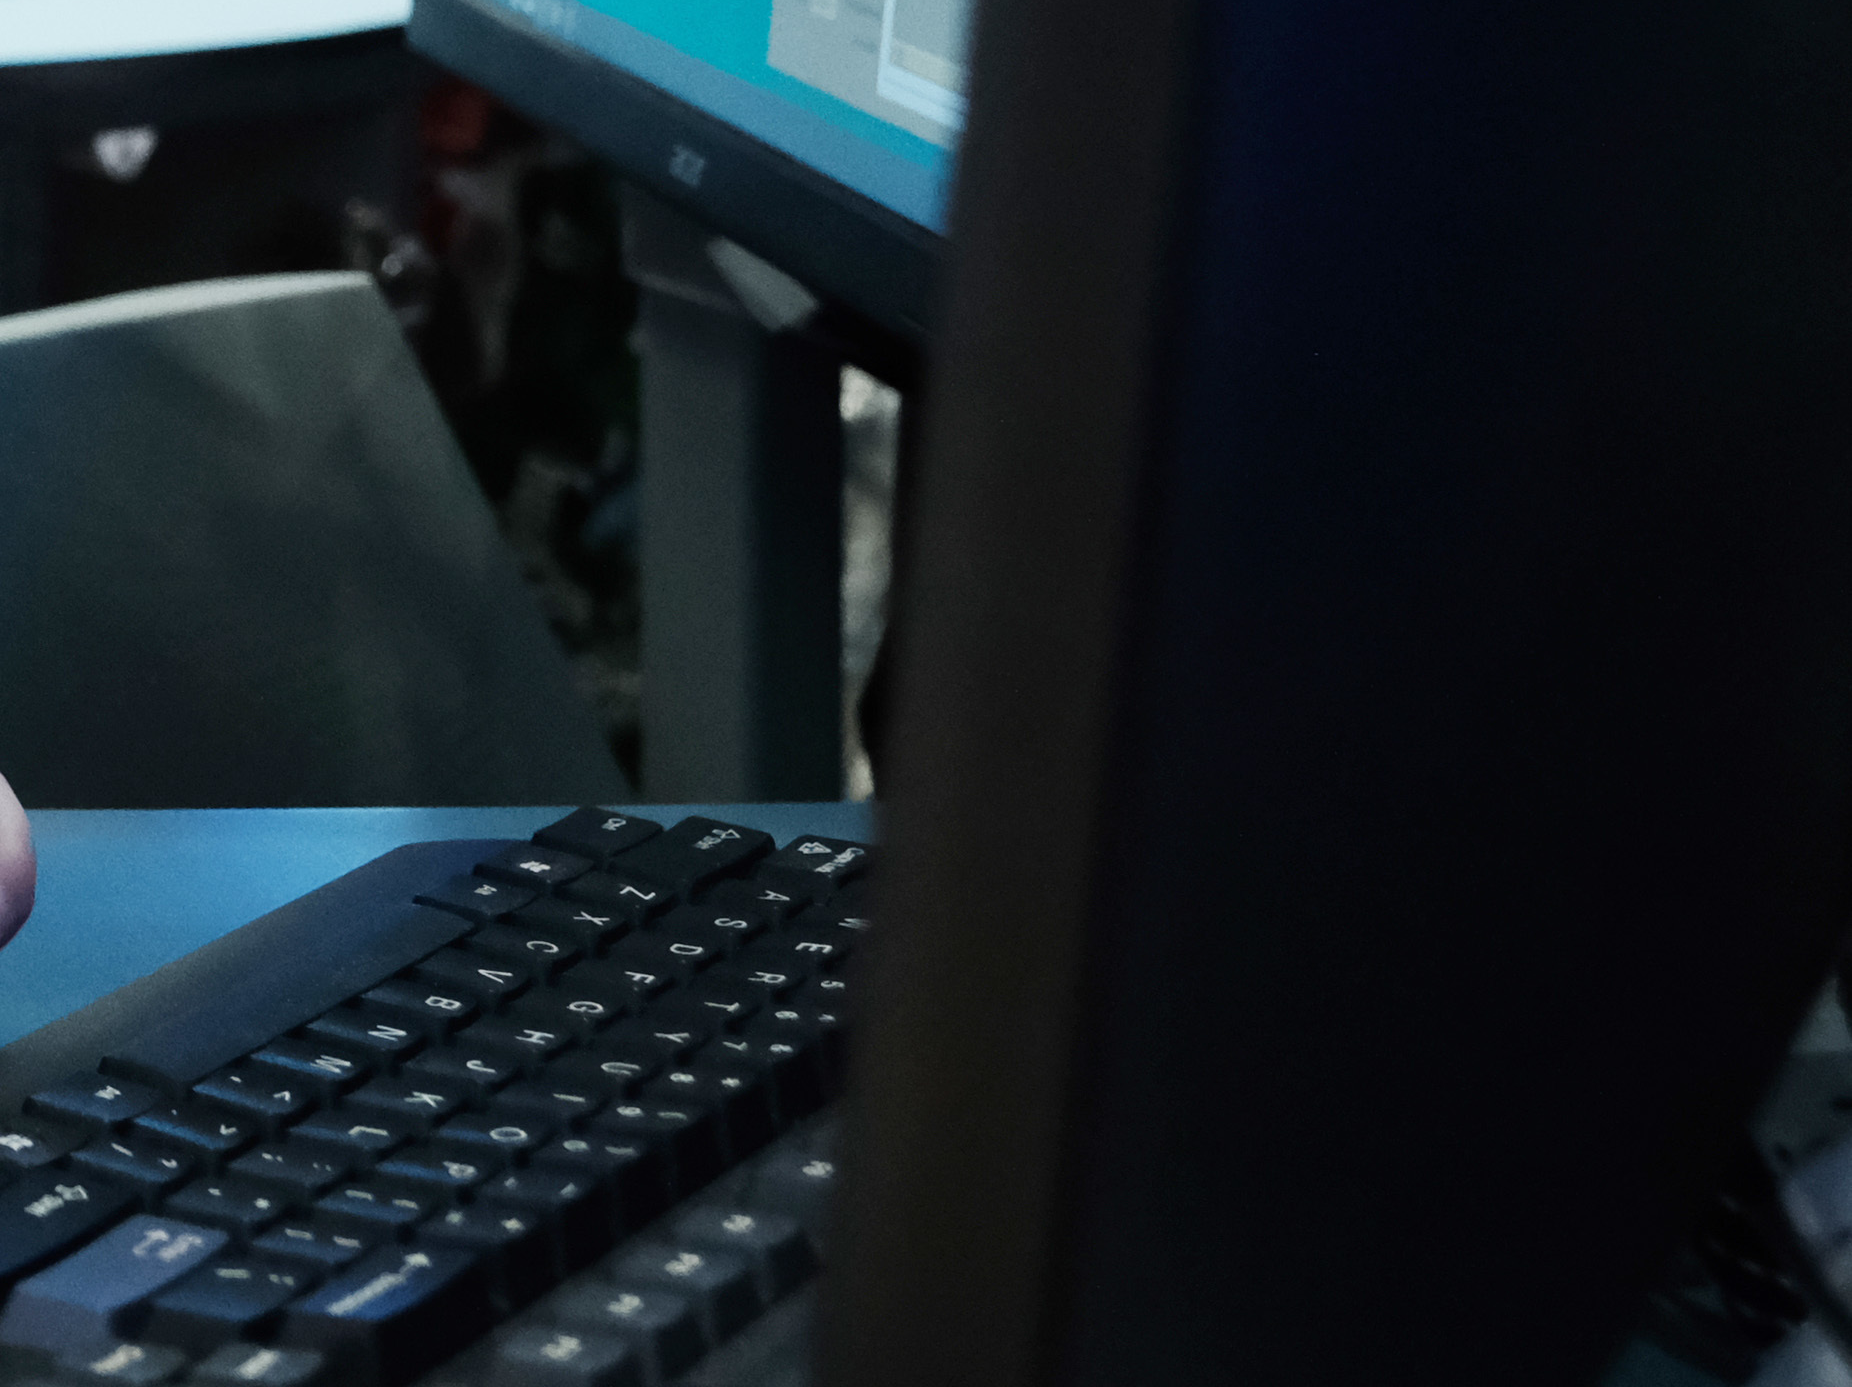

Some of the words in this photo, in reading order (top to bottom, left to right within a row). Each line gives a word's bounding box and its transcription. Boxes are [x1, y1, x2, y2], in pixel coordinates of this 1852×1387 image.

[619, 884, 657, 902] Z
[758, 888, 792, 904] A
[573, 910, 611, 927] X
[714, 916, 748, 929] S
[525, 938, 560, 955] C
[669, 942, 705, 957] D
[794, 940, 834, 955] E
[477, 967, 514, 984] V
[624, 969, 657, 986] F
[747, 970, 787, 986] R
[424, 994, 462, 1012] B
[567, 999, 605, 1016] G
[367, 1023, 409, 1043] N
[514, 1028, 556, 1046] H
[309, 1054, 354, 1075] M
[465, 1058, 498, 1075] J
[404, 1090, 446, 1109] K
